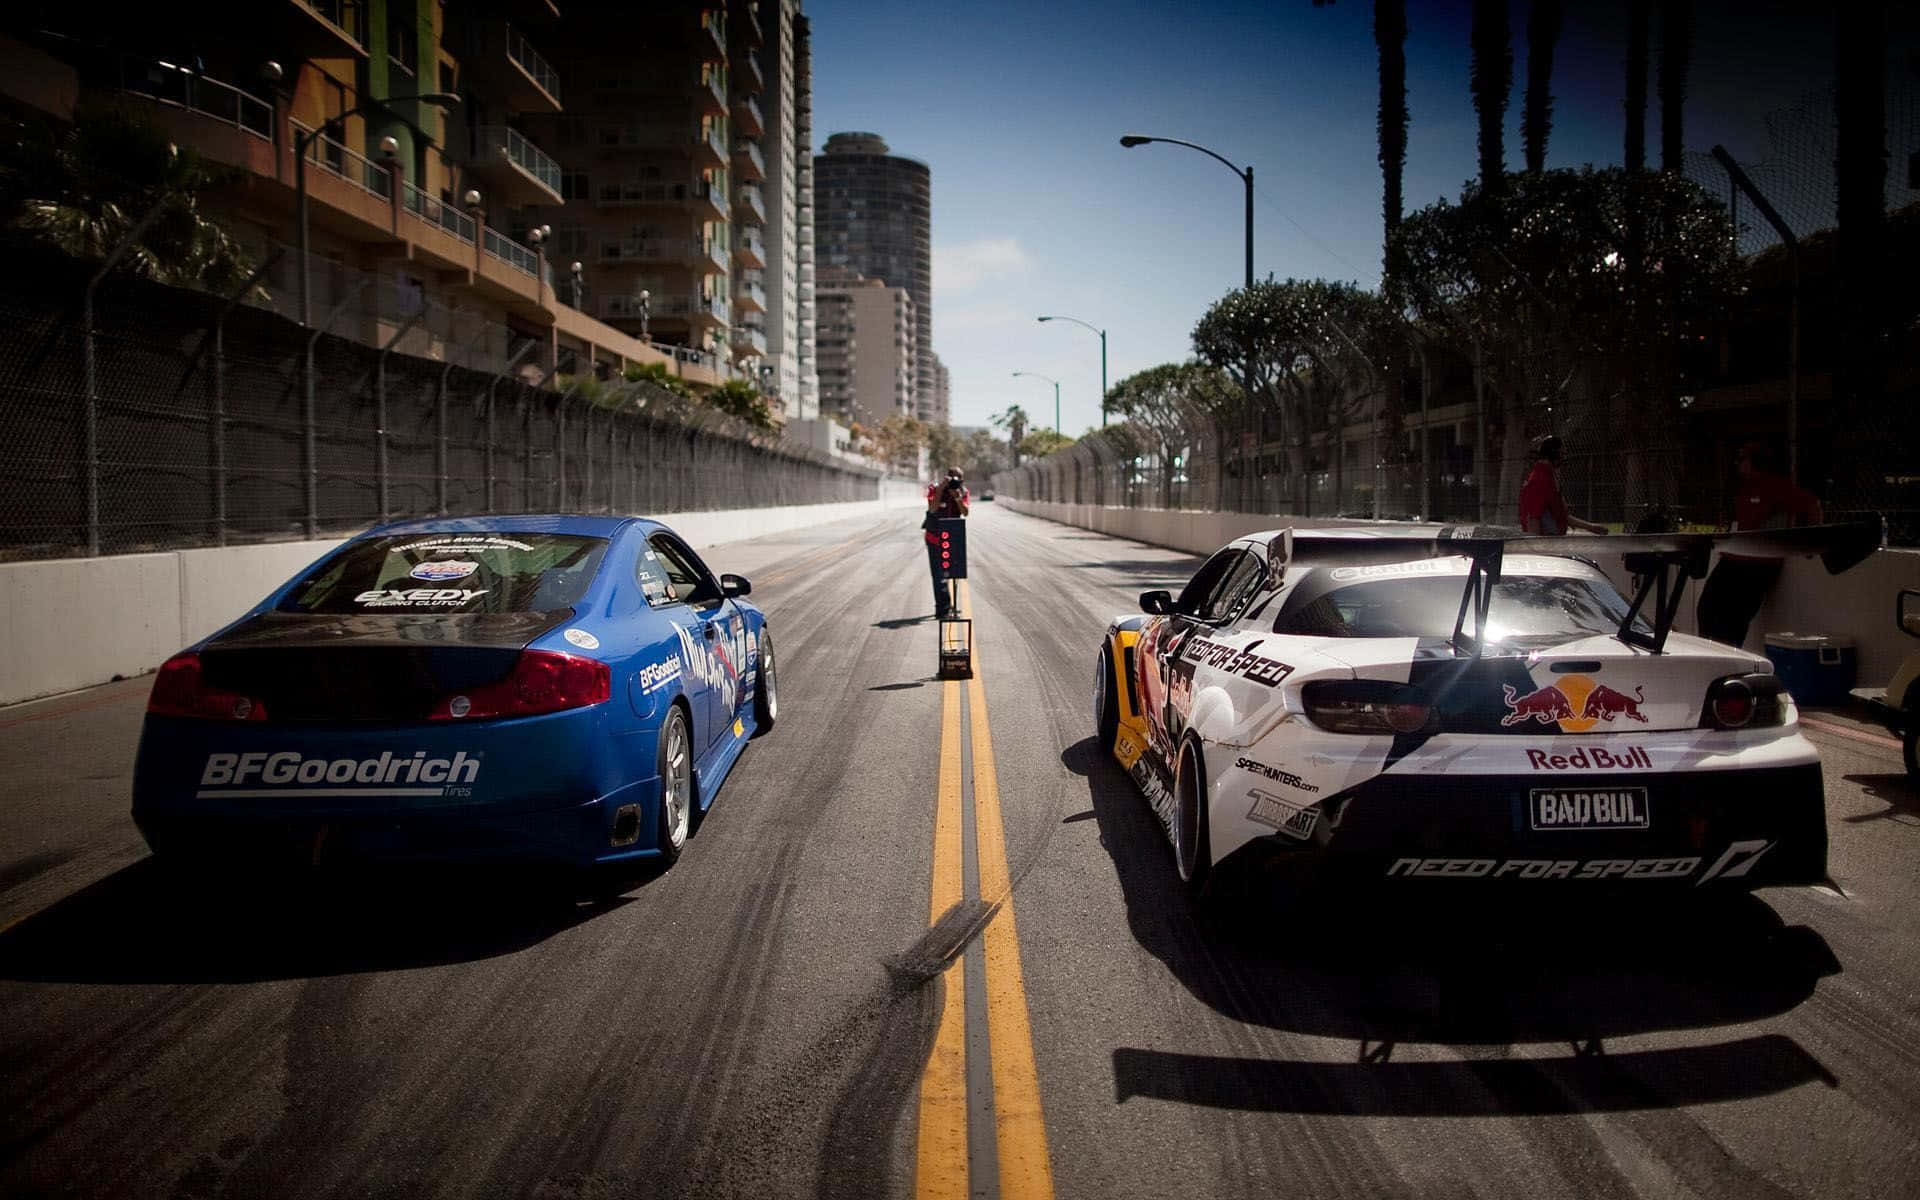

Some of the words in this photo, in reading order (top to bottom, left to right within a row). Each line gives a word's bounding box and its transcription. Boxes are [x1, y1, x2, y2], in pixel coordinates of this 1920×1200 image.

[353, 588, 490, 603] EXEDY
[363, 600, 413, 608] RACING
[415, 599, 468, 607] CLUTCH
[640, 653, 681, 689] BFGoodrich
[1208, 644, 1238, 670] FOR
[1224, 650, 1296, 688] SPEED
[200, 751, 481, 785] BFGoodrich
[1526, 747, 1592, 770] Red
[1590, 746, 1652, 770] Bull
[443, 784, 472, 798] Tires
[1387, 858, 1497, 879] NEED
[1493, 858, 1580, 879] FOR
[1579, 856, 1702, 879] SPEED
